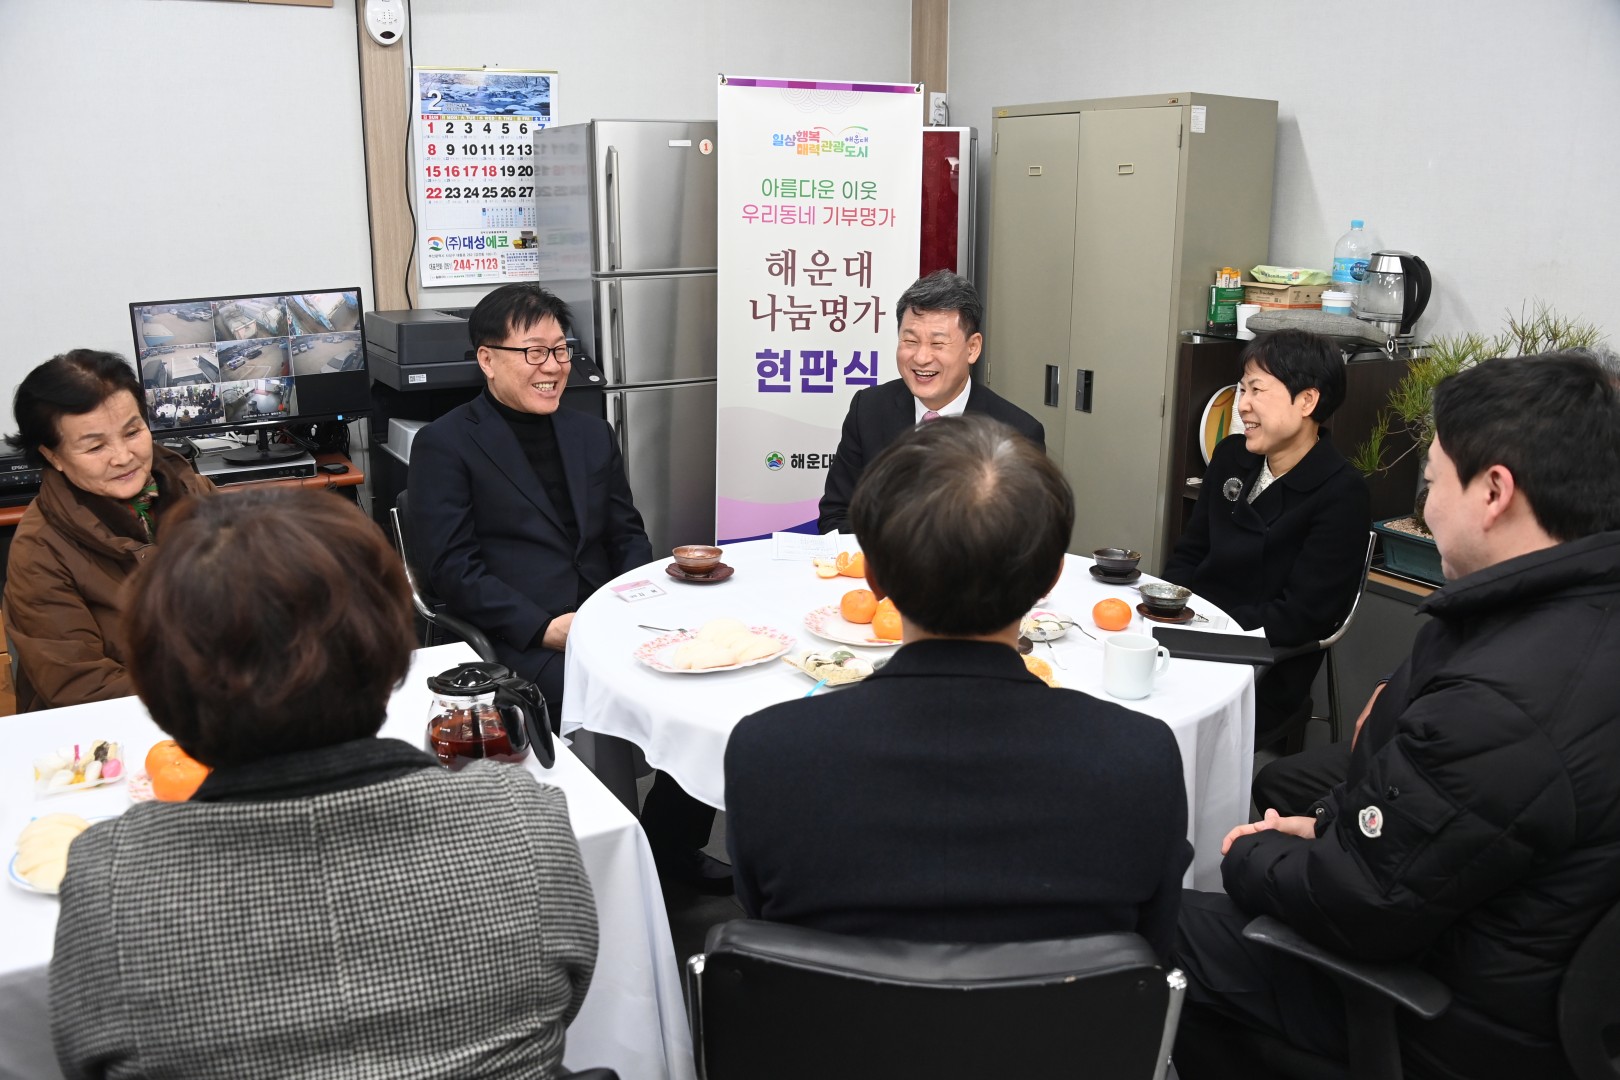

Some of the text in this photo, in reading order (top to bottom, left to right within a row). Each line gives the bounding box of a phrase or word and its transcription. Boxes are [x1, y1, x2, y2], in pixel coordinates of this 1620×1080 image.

[427, 89, 443, 111] 2
[427, 122, 434, 134] 1
[445, 122, 454, 134] 2
[464, 122, 473, 134] 3
[483, 123, 492, 134] 4
[501, 123, 510, 134] 5
[519, 123, 528, 135] 6
[772, 130, 820, 147] 일상 행복
[427, 143, 533, 156] 8 9 10 11 12 13
[796, 140, 868, 158] 매력 관광 도시
[425, 165, 534, 177] 15 16 17 18 19 20
[426, 186, 534, 199] 22 23 24 25 26 27
[761, 178, 878, 201] 아름다운 이웃
[741, 204, 896, 227] 우리동네 기부명가
[445, 235, 509, 251] (주)대성에코
[453, 257, 498, 271] 244-7123
[765, 248, 873, 289] 해운대
[749, 293, 887, 334] 나눔명가
[755, 348, 879, 394] 현판식
[790, 453, 836, 470] 해운대
